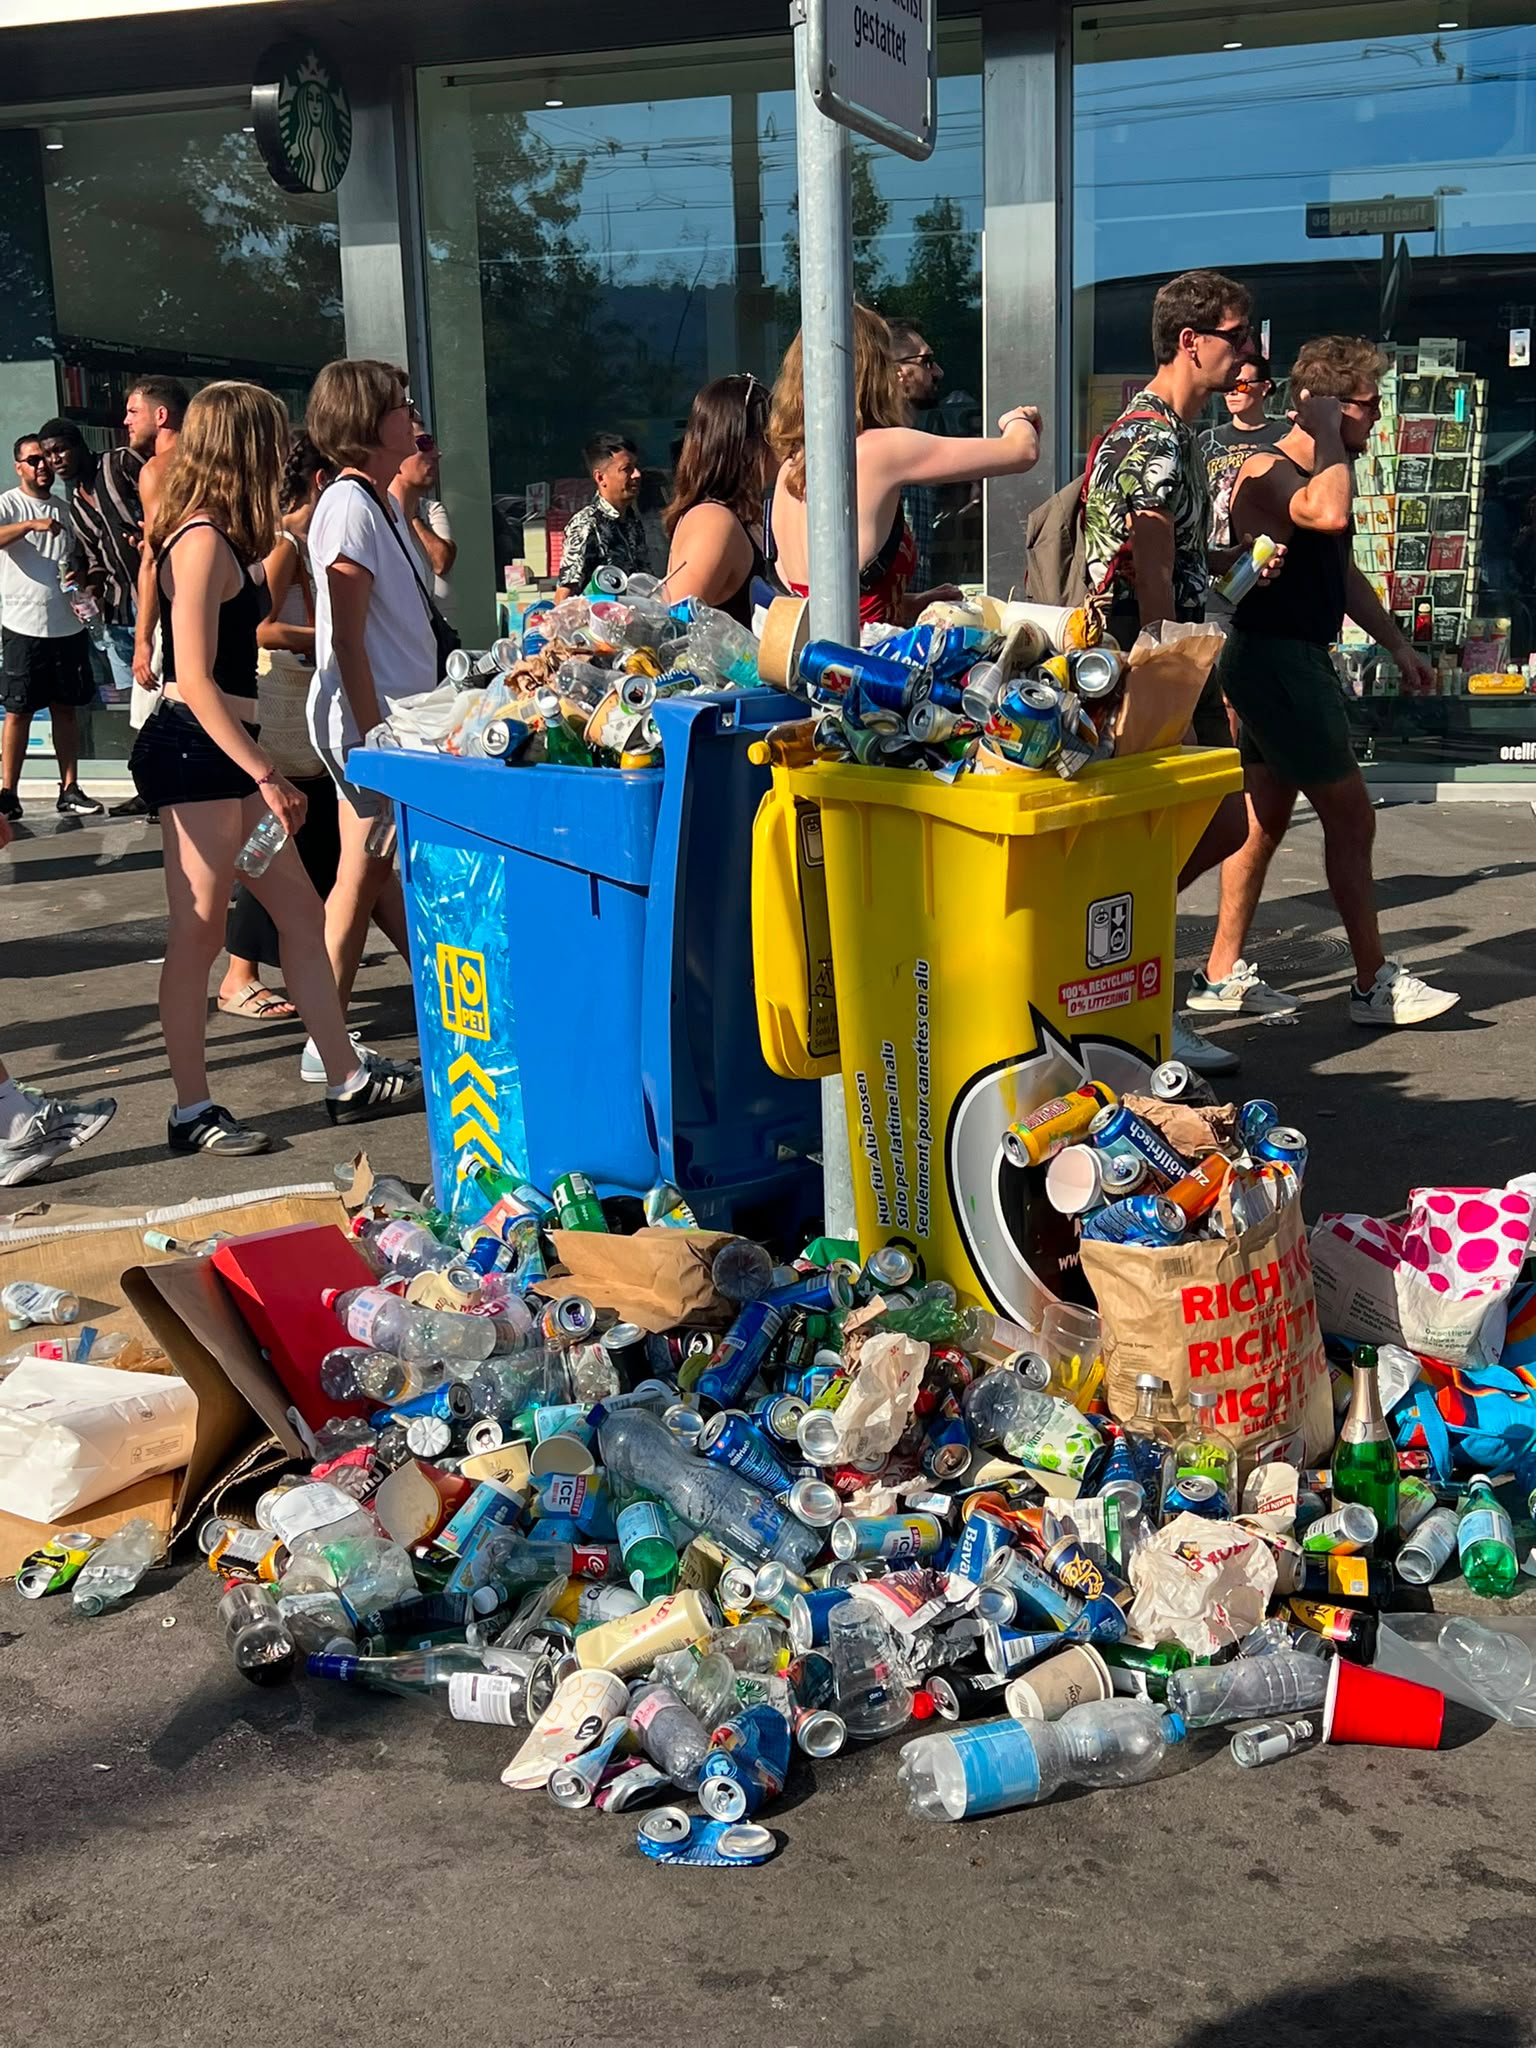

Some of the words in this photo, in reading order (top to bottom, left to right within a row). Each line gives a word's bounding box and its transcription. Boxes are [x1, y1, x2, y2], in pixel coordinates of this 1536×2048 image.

[853, 4, 907, 66] gestattet
[914, 959, 930, 990] alu
[1061, 983, 1088, 1000] 100%
[1088, 969, 1135, 993] RECYCLING
[915, 993, 929, 1016] en
[1070, 1000, 1086, 1013] 0%
[1087, 989, 1130, 1010] LITTERING
[462, 1007, 485, 1032] PET
[881, 1040, 897, 1073] alu
[912, 1019, 930, 1096] canettes
[885, 1076, 899, 1093] in
[855, 1071, 879, 1160] Alu-Dosen
[885, 1097, 904, 1155] lattine
[916, 1099, 934, 1143] pour
[1129, 1120, 1188, 1181] uöllfrisch
[871, 1165, 884, 1192] für
[892, 1157, 911, 1192] per
[914, 1140, 931, 1238] Seulement
[877, 1196, 890, 1226] Nur
[894, 1192, 910, 1229] Solo
[1250, 1298, 1292, 1326] FRISCH
[558, 1480, 574, 1505] ICE
